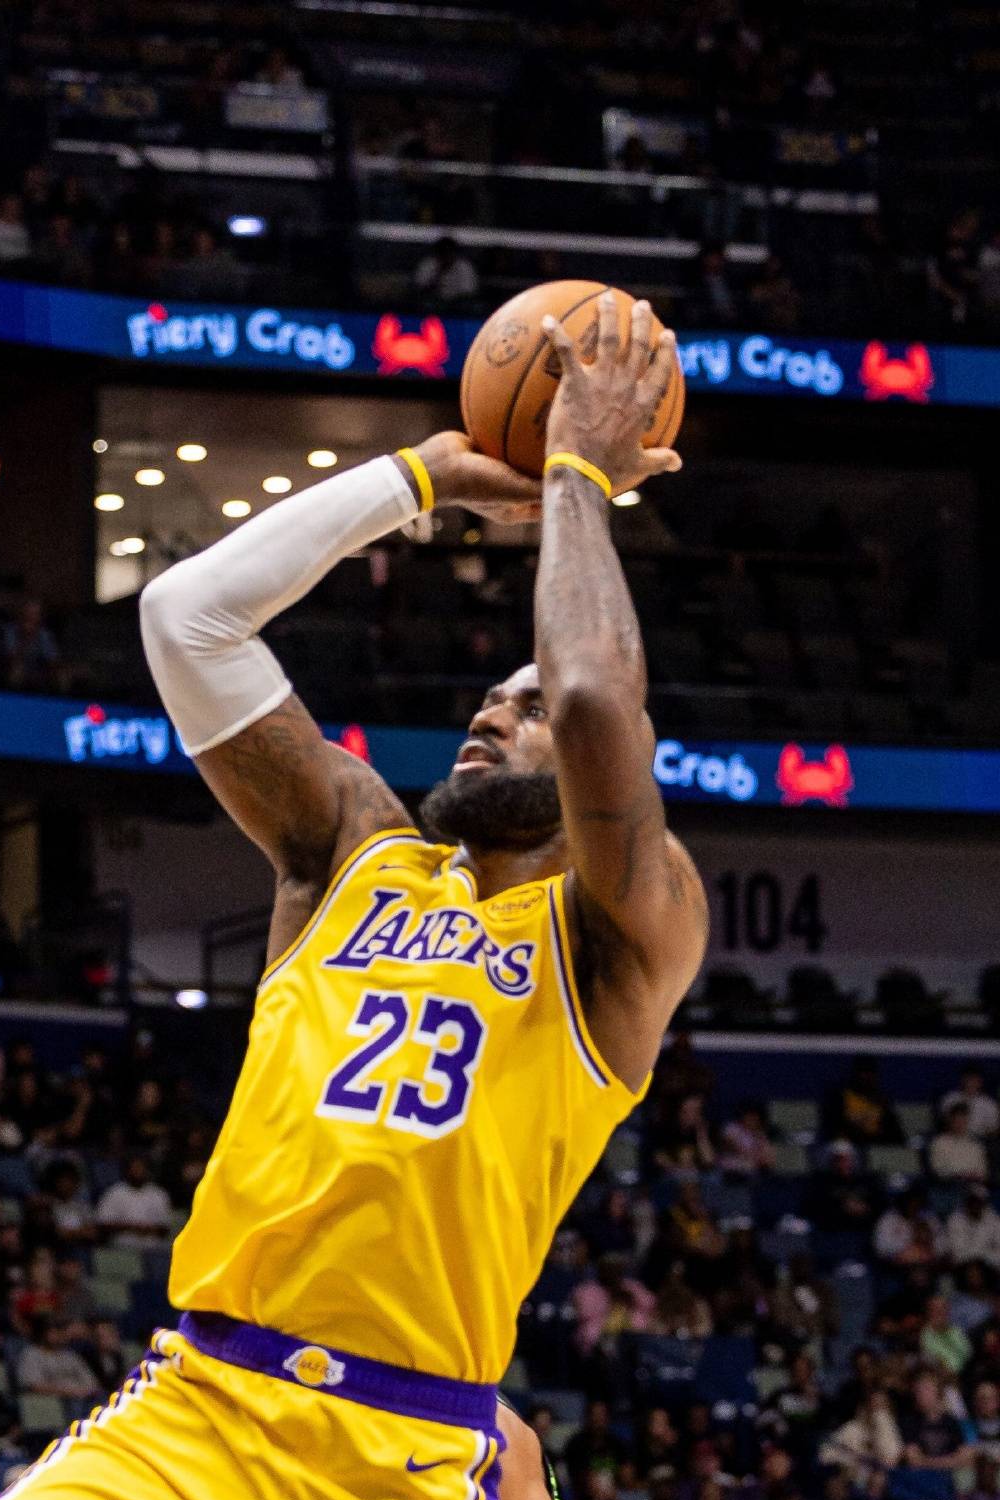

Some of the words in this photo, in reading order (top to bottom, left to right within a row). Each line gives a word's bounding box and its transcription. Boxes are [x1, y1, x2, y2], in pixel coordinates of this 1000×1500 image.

[127, 304, 238, 358] Fiery
[64, 704, 171, 764] Fiery
[322, 888, 536, 999] LAKERS
[716, 871, 829, 953] 104
[315, 989, 488, 1139] 23
